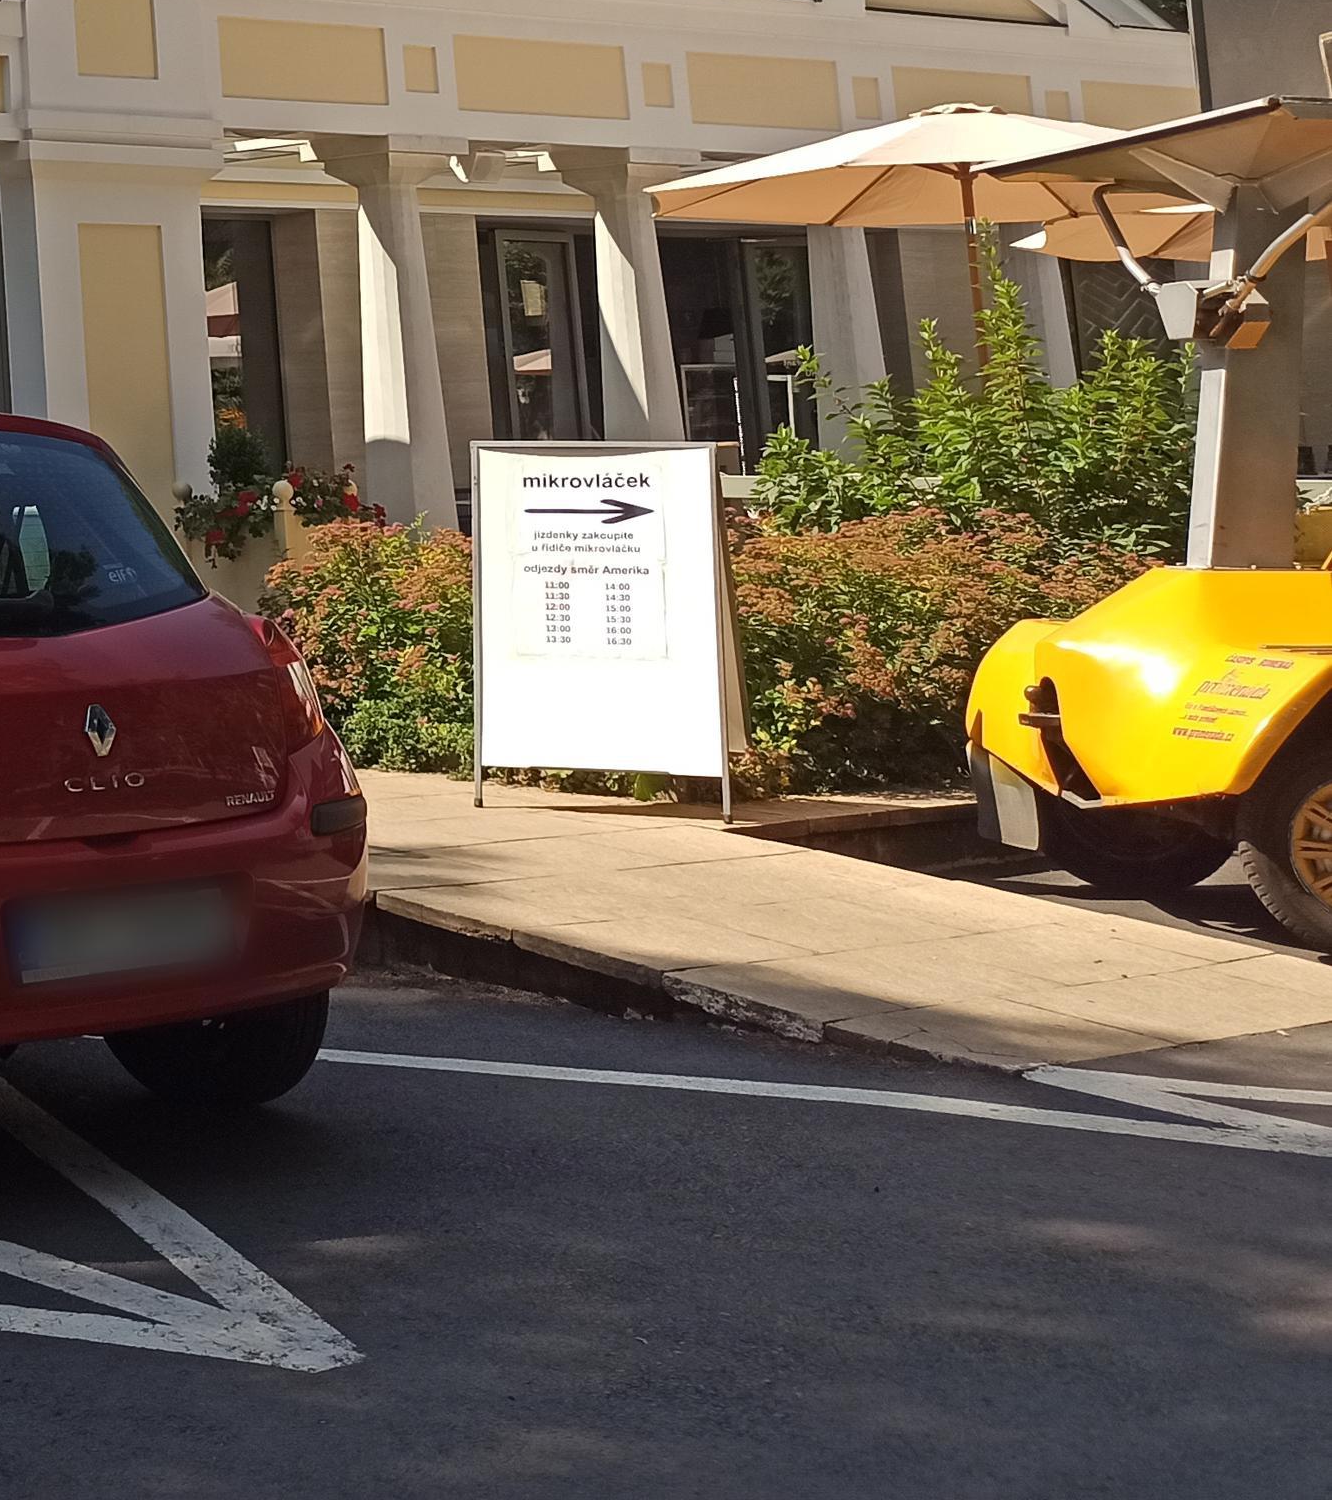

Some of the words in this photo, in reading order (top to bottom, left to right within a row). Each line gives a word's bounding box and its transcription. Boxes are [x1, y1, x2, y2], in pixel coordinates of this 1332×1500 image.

[523, 473, 651, 489] mikrovláček
[524, 564, 568, 575] odjezdy
[570, 564, 599, 575] směr
[602, 565, 650, 575] Amerika
[545, 581, 570, 589] 11:00
[545, 592, 570, 600] 11:30
[545, 603, 570, 611] 12:00
[545, 614, 571, 622] 12:30
[64, 772, 145, 792] CLIO
[225, 790, 275, 807] RENAULT
